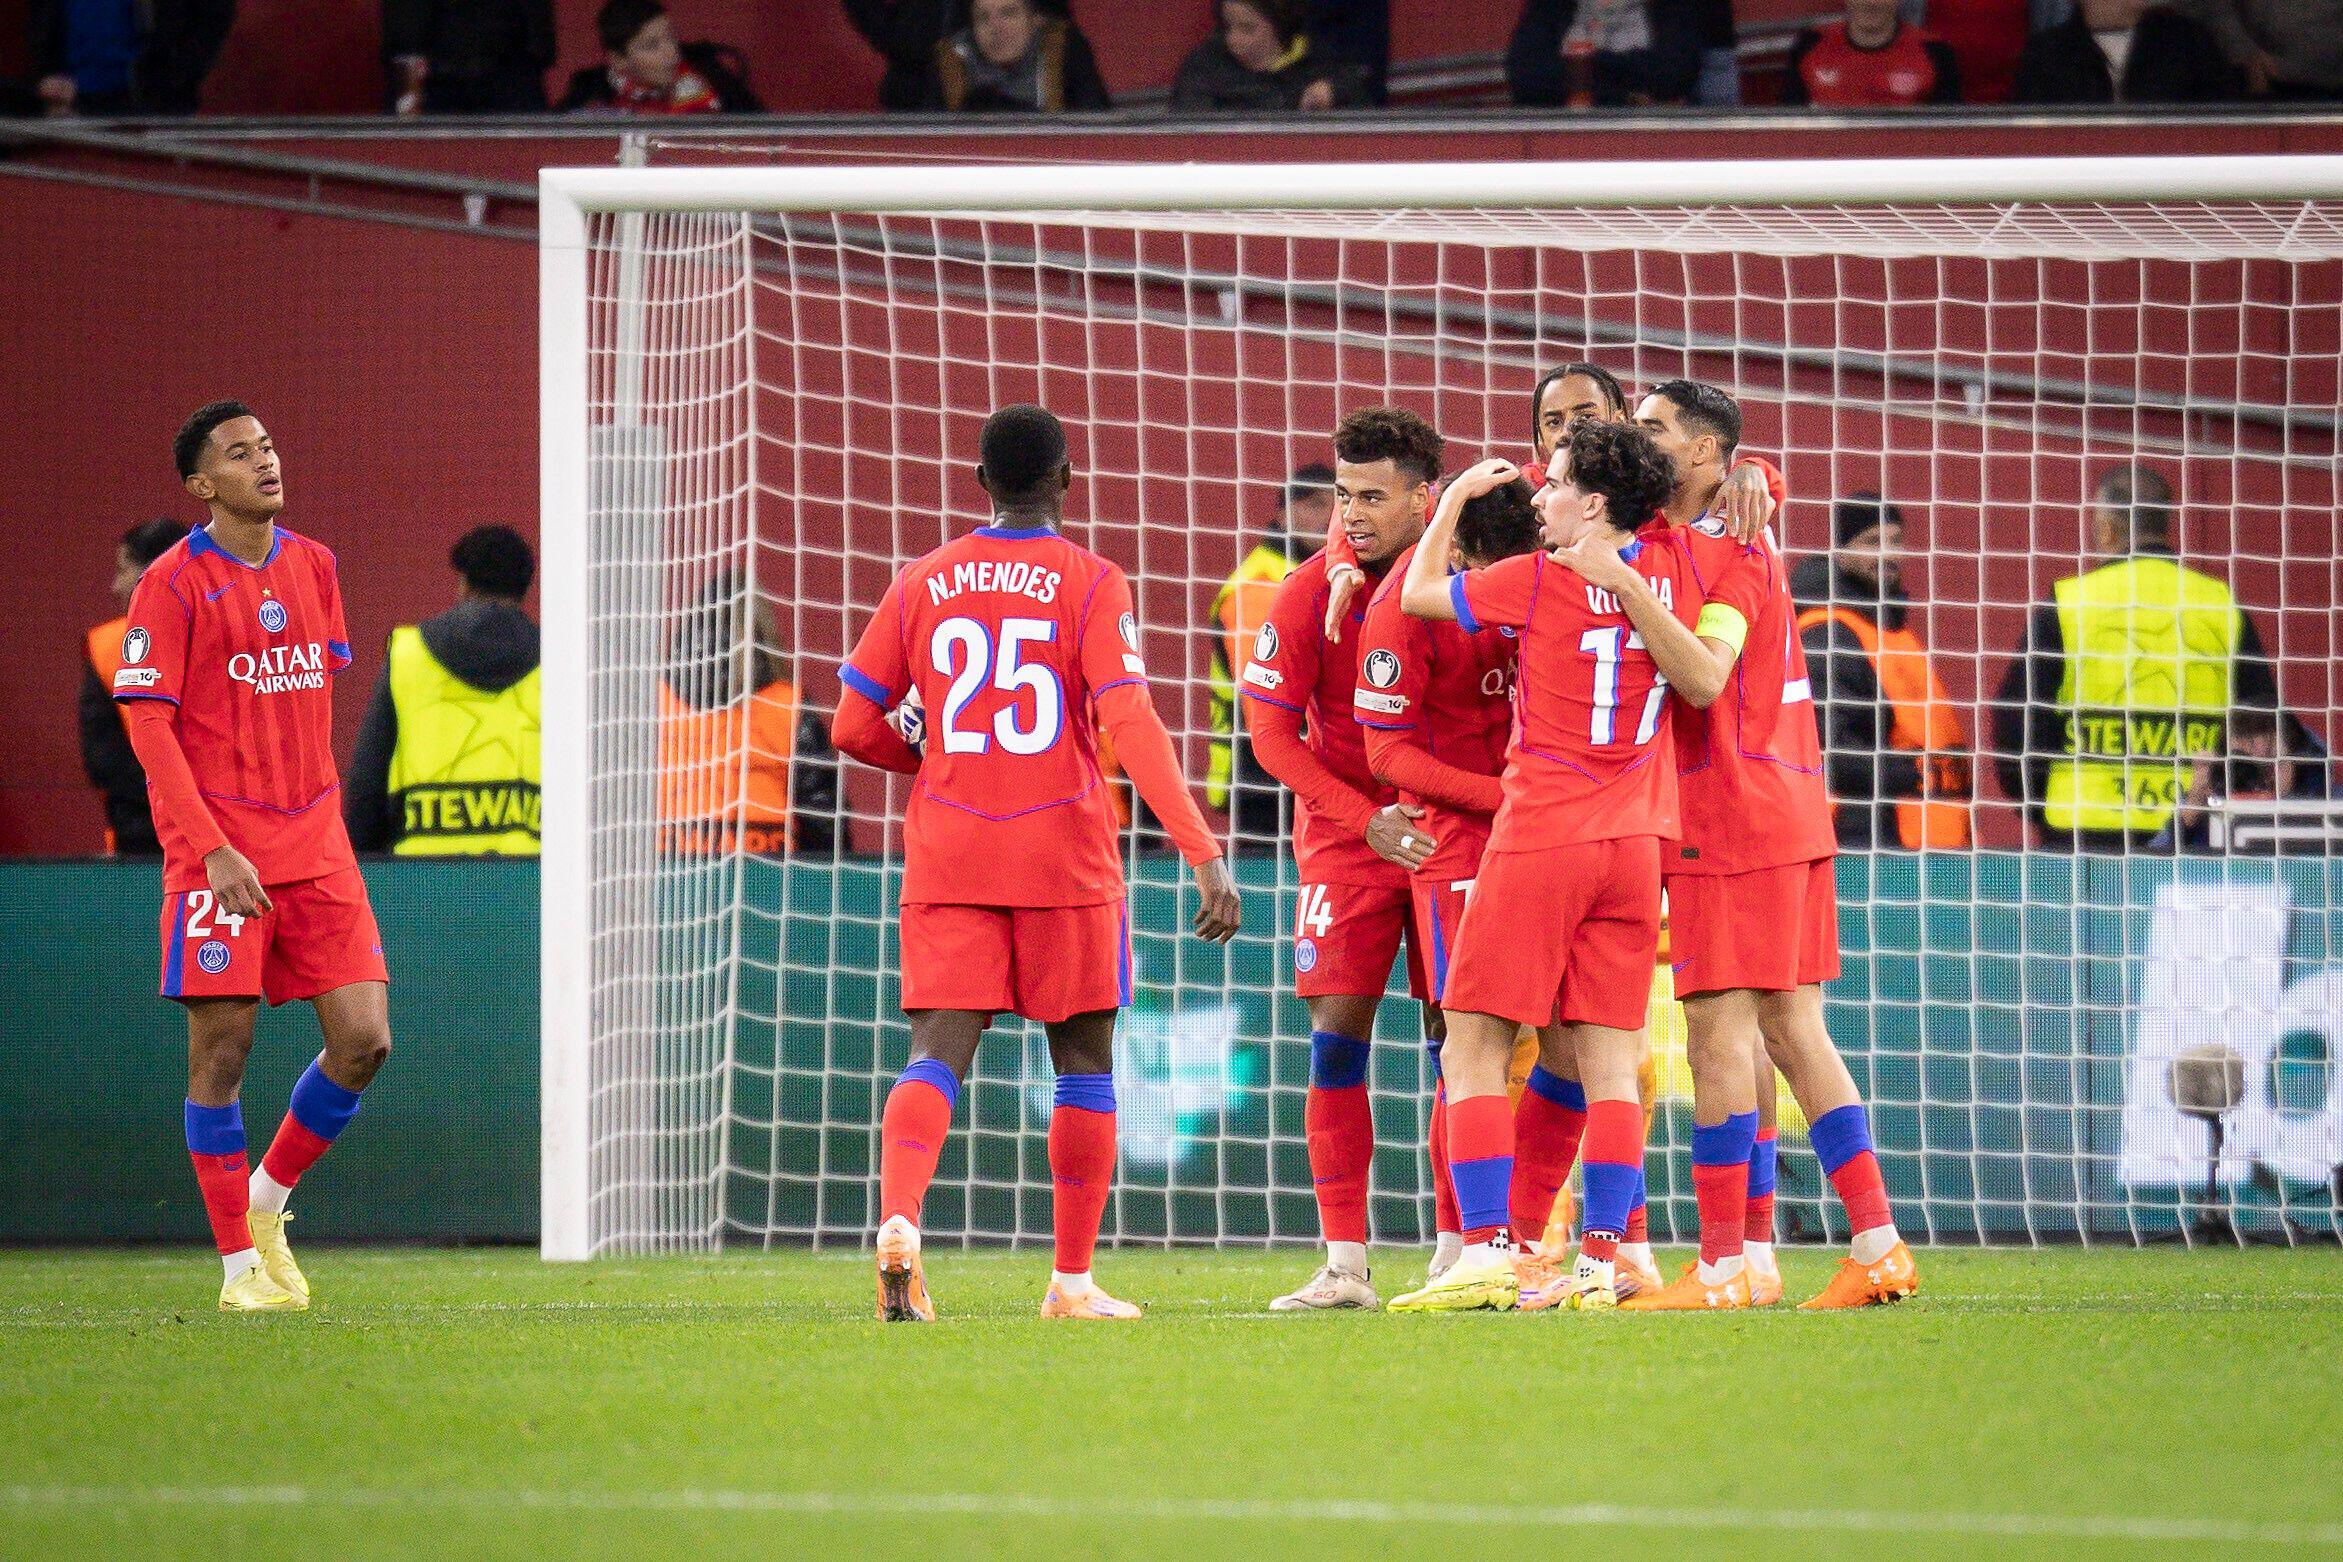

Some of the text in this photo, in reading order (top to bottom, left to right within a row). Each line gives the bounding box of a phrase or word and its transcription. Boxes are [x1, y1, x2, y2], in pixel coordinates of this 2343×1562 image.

[927, 561, 1062, 606] N.MENDES
[228, 643, 324, 685] QATAR
[255, 671, 325, 695] AIRWAYS
[930, 616, 1064, 755] 25
[186, 889, 246, 938] 24
[1297, 884, 1334, 937] 14
